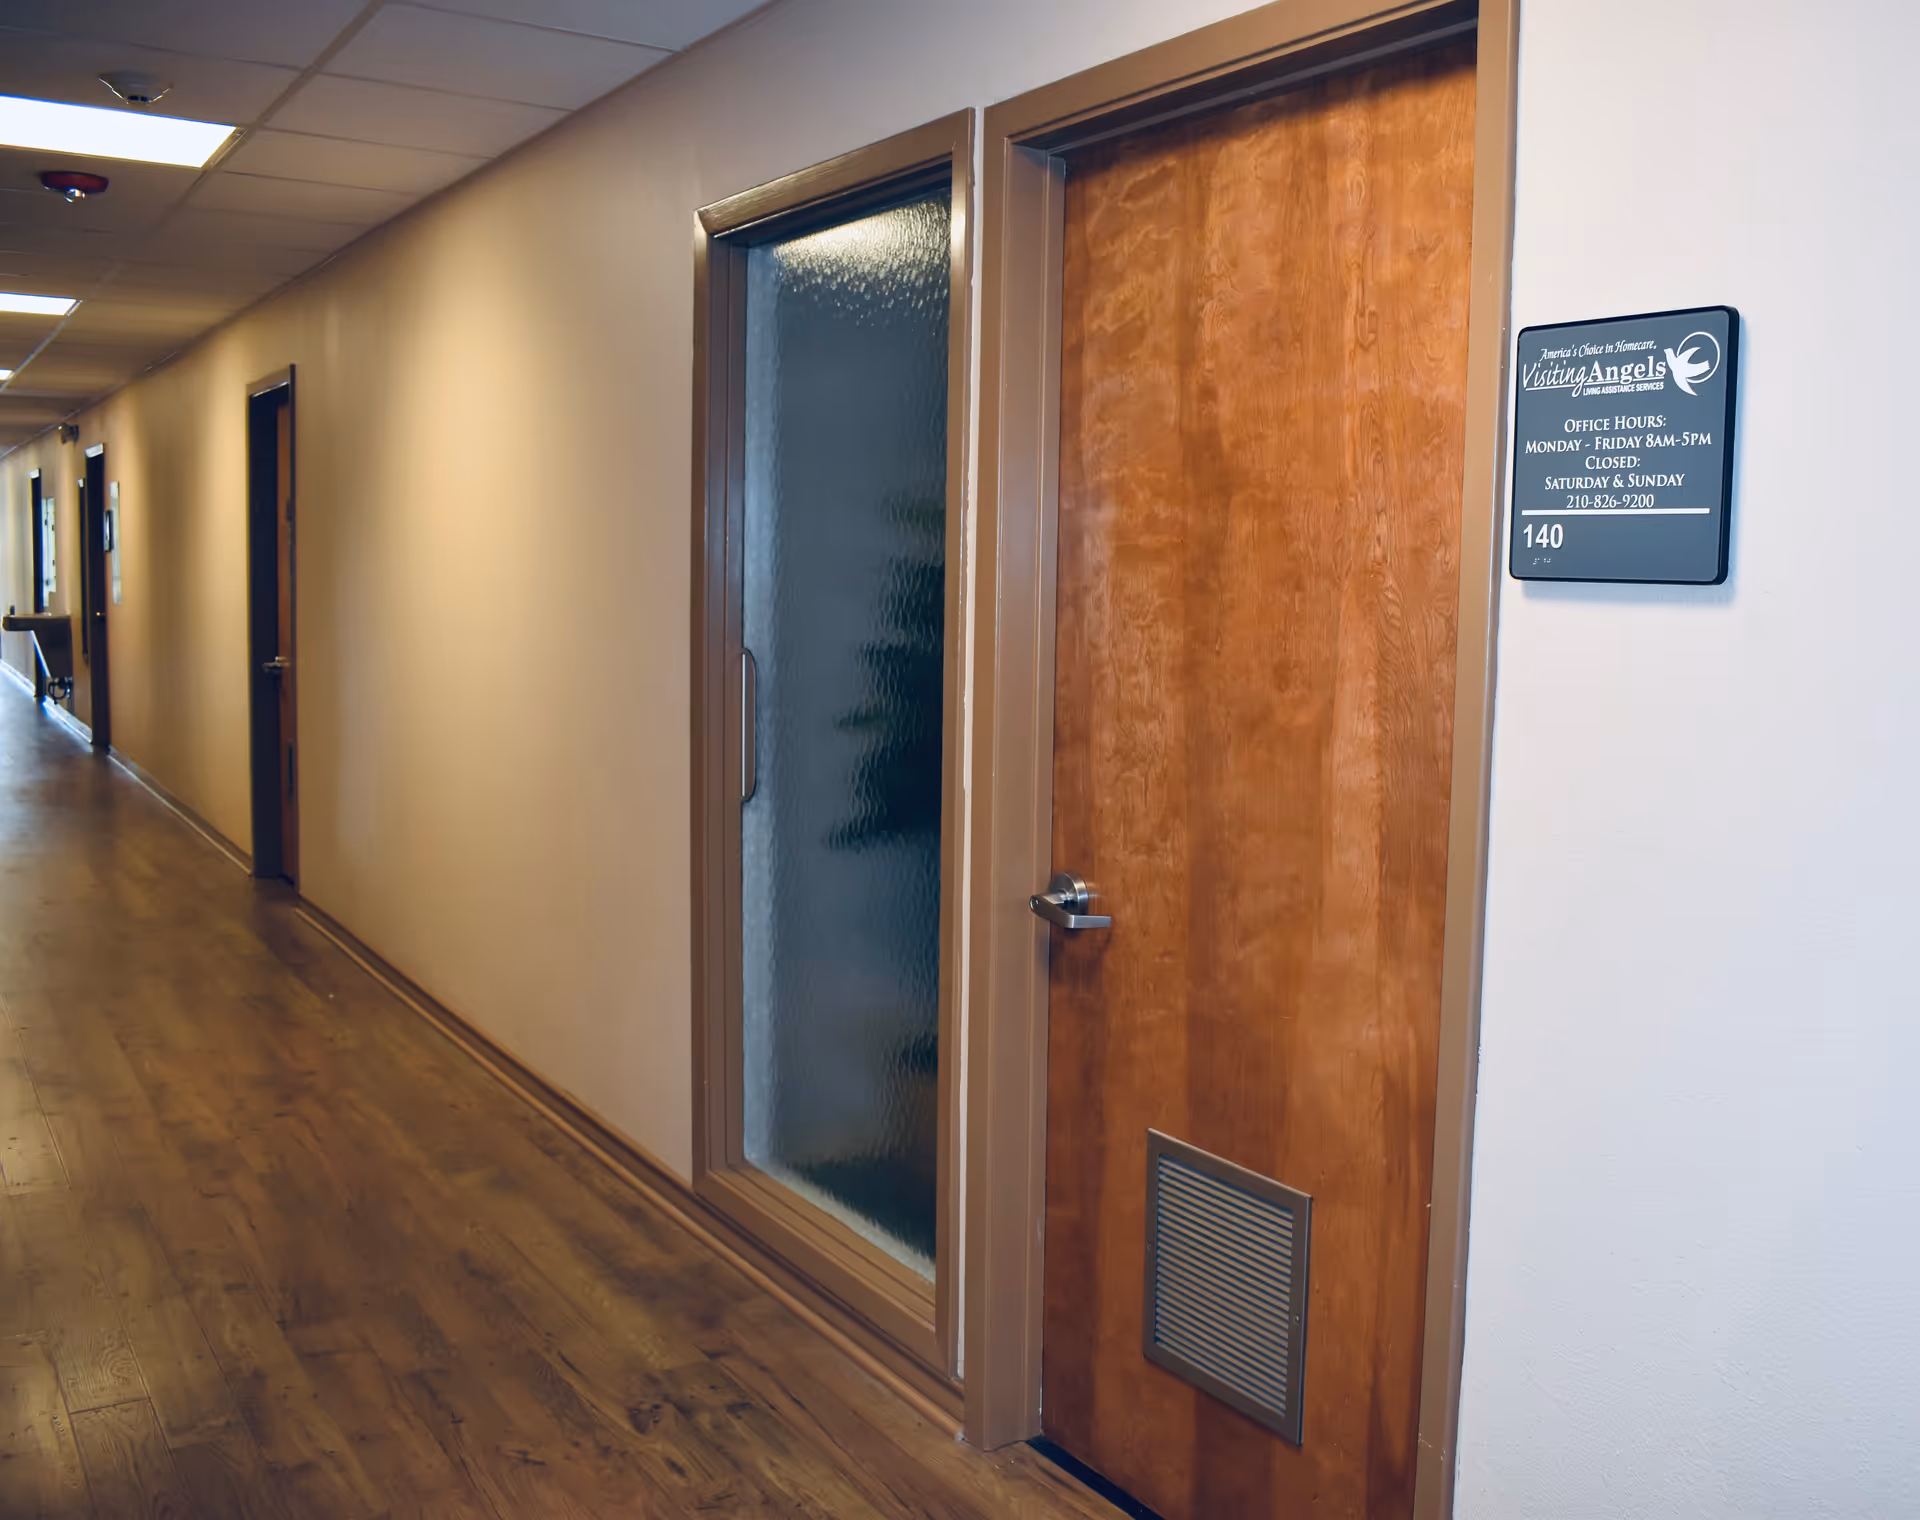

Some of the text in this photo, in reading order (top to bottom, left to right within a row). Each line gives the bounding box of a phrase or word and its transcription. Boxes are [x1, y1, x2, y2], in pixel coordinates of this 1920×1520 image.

[1539, 344, 1577, 361] America's
[1578, 342, 1604, 357] Choice
[1605, 343, 1613, 354] in
[1587, 355, 1666, 384] Angels
[1583, 382, 1664, 396] LIVING ASSISTANCE SERVICES
[1564, 415, 1667, 433] OFFICE HOURS:
[1525, 439, 1583, 454] MONDAY
[1594, 435, 1643, 450] FRIDAY
[1645, 432, 1712, 448] 8AM-5PM
[1585, 455, 1641, 470] CLOSED:
[1544, 473, 1685, 491] SATURDAY & SUNDAY
[1566, 494, 1655, 509] 210-826-9200
[1523, 523, 1564, 549] 140
